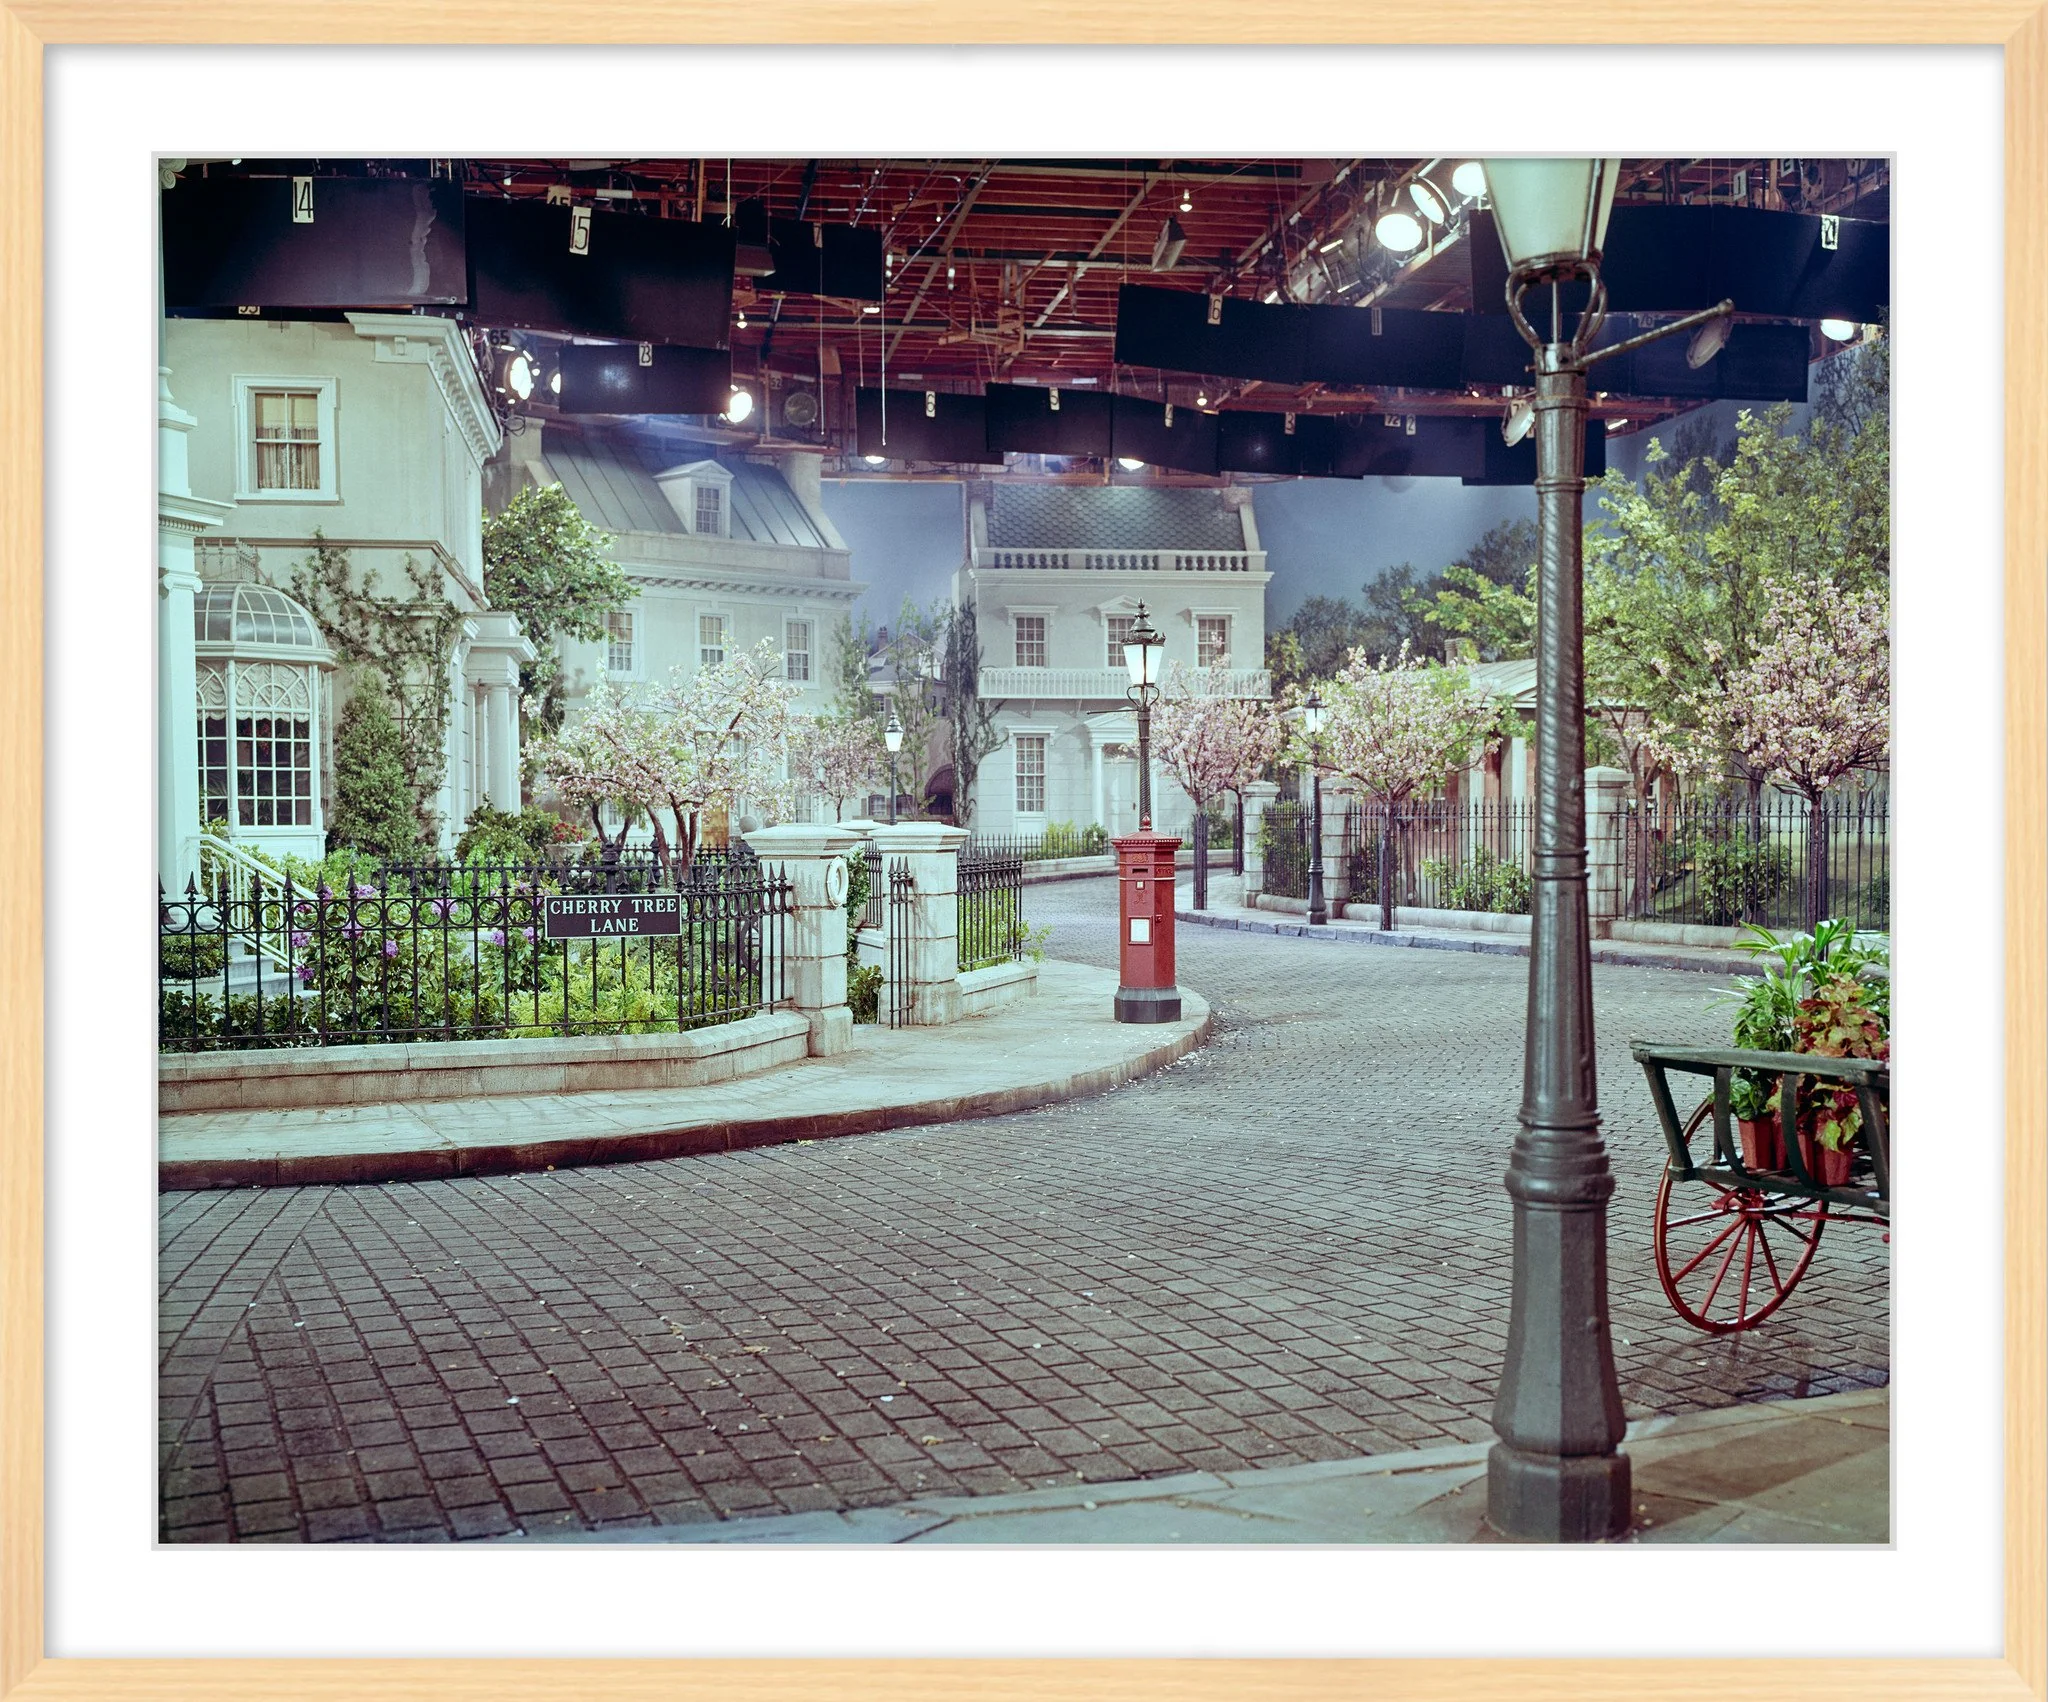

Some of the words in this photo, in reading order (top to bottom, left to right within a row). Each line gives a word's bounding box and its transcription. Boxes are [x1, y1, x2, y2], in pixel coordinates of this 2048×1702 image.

[294, 181, 313, 218] 14
[571, 215, 591, 249] 15
[490, 329, 509, 345] 65
[927, 393, 935, 412] 6
[550, 899, 623, 915] CHERRY
[631, 898, 677, 913] TREE
[590, 918, 639, 933] LANE
